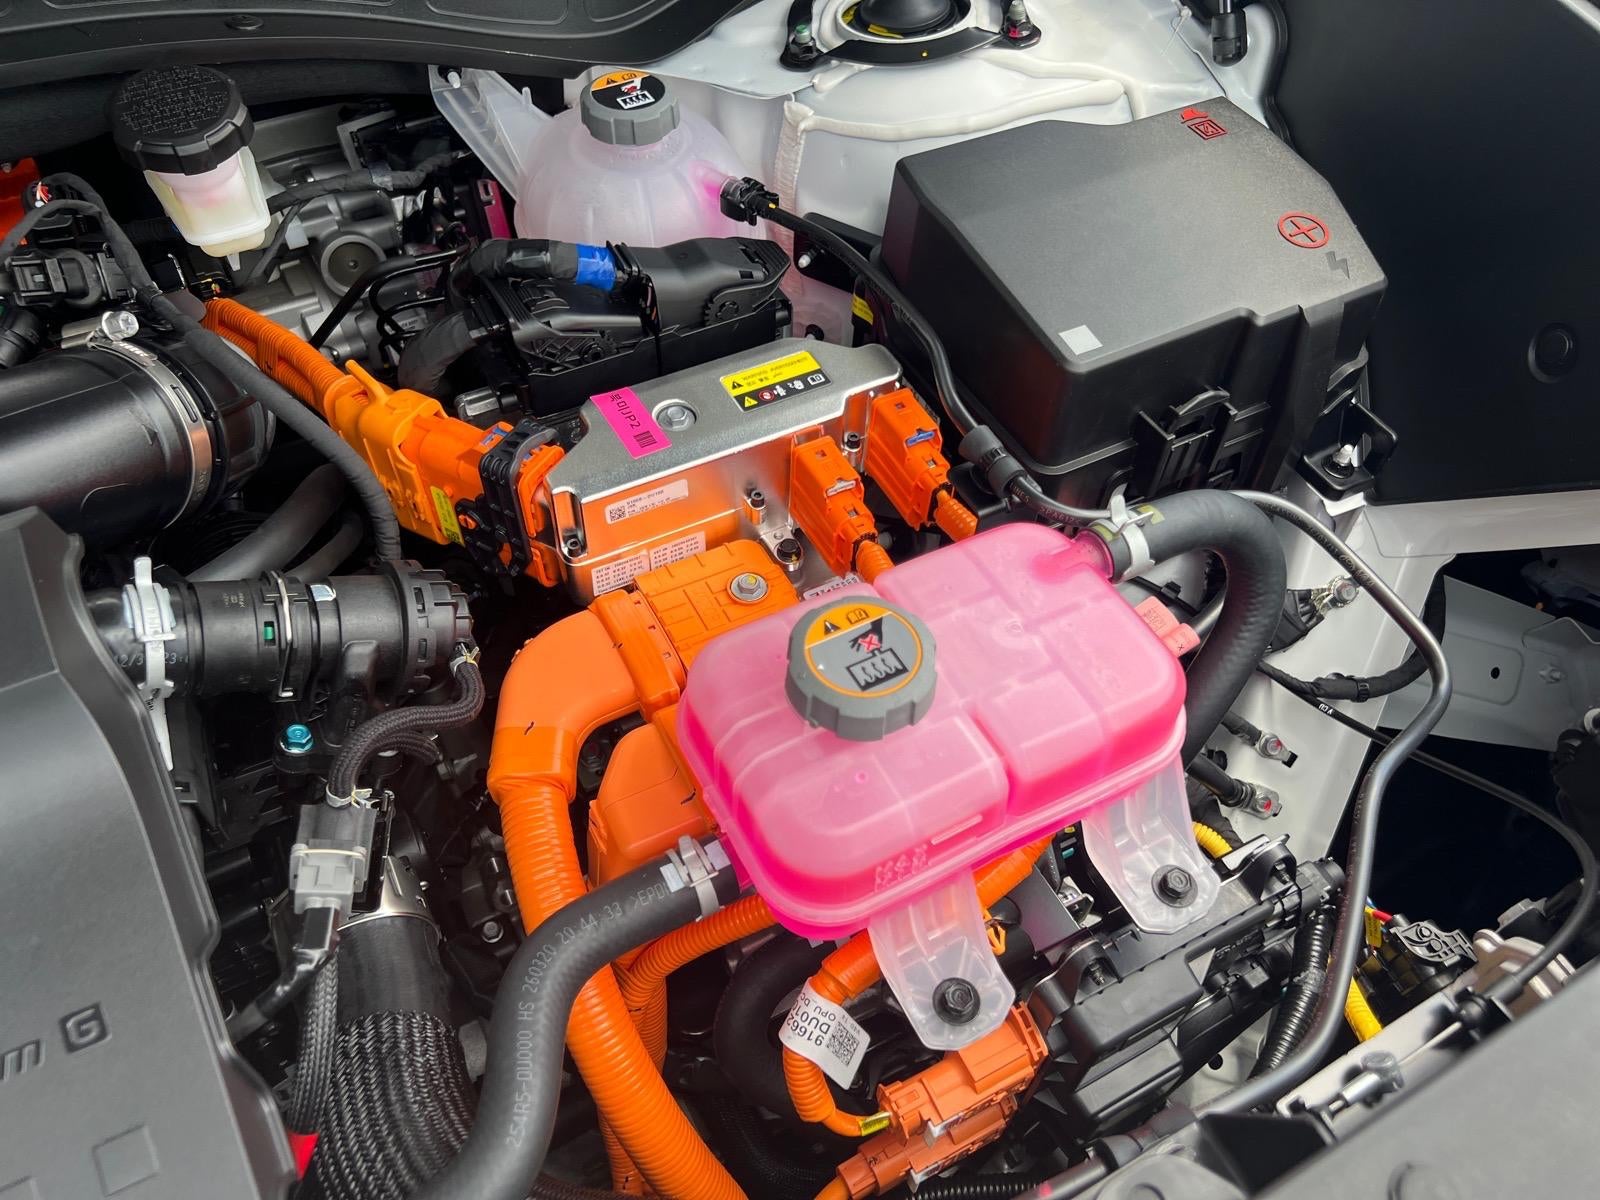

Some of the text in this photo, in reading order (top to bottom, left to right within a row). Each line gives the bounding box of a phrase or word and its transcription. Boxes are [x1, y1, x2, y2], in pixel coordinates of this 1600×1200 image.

[522, 944, 557, 993] 260320
[62, 1004, 104, 1048] G
[517, 1001, 534, 1020] HS
